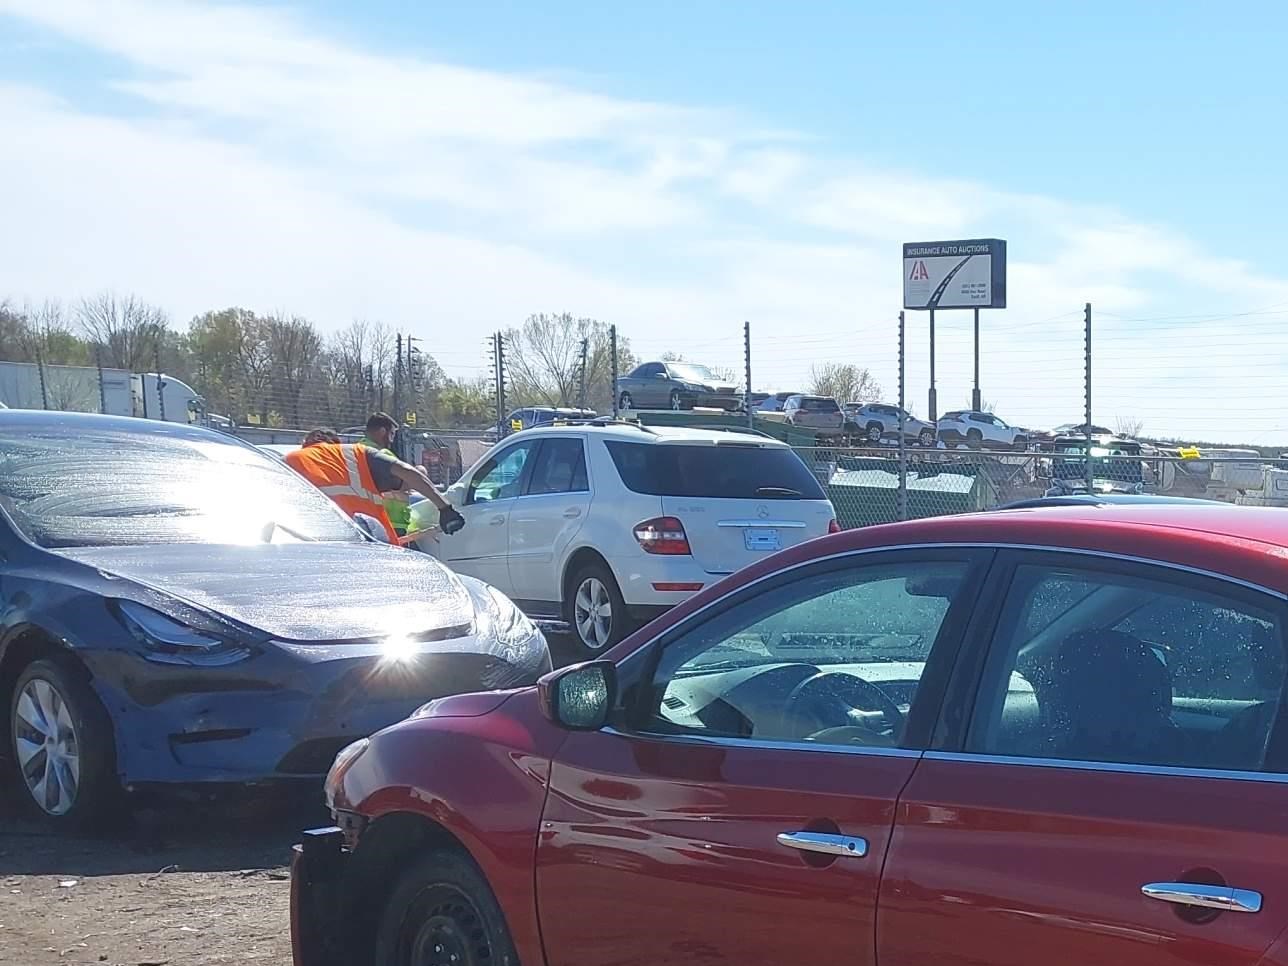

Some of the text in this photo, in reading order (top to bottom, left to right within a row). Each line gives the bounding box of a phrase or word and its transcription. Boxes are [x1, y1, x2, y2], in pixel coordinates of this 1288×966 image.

[907, 244, 989, 256] INSURANCE AUTO AUCTIONS
